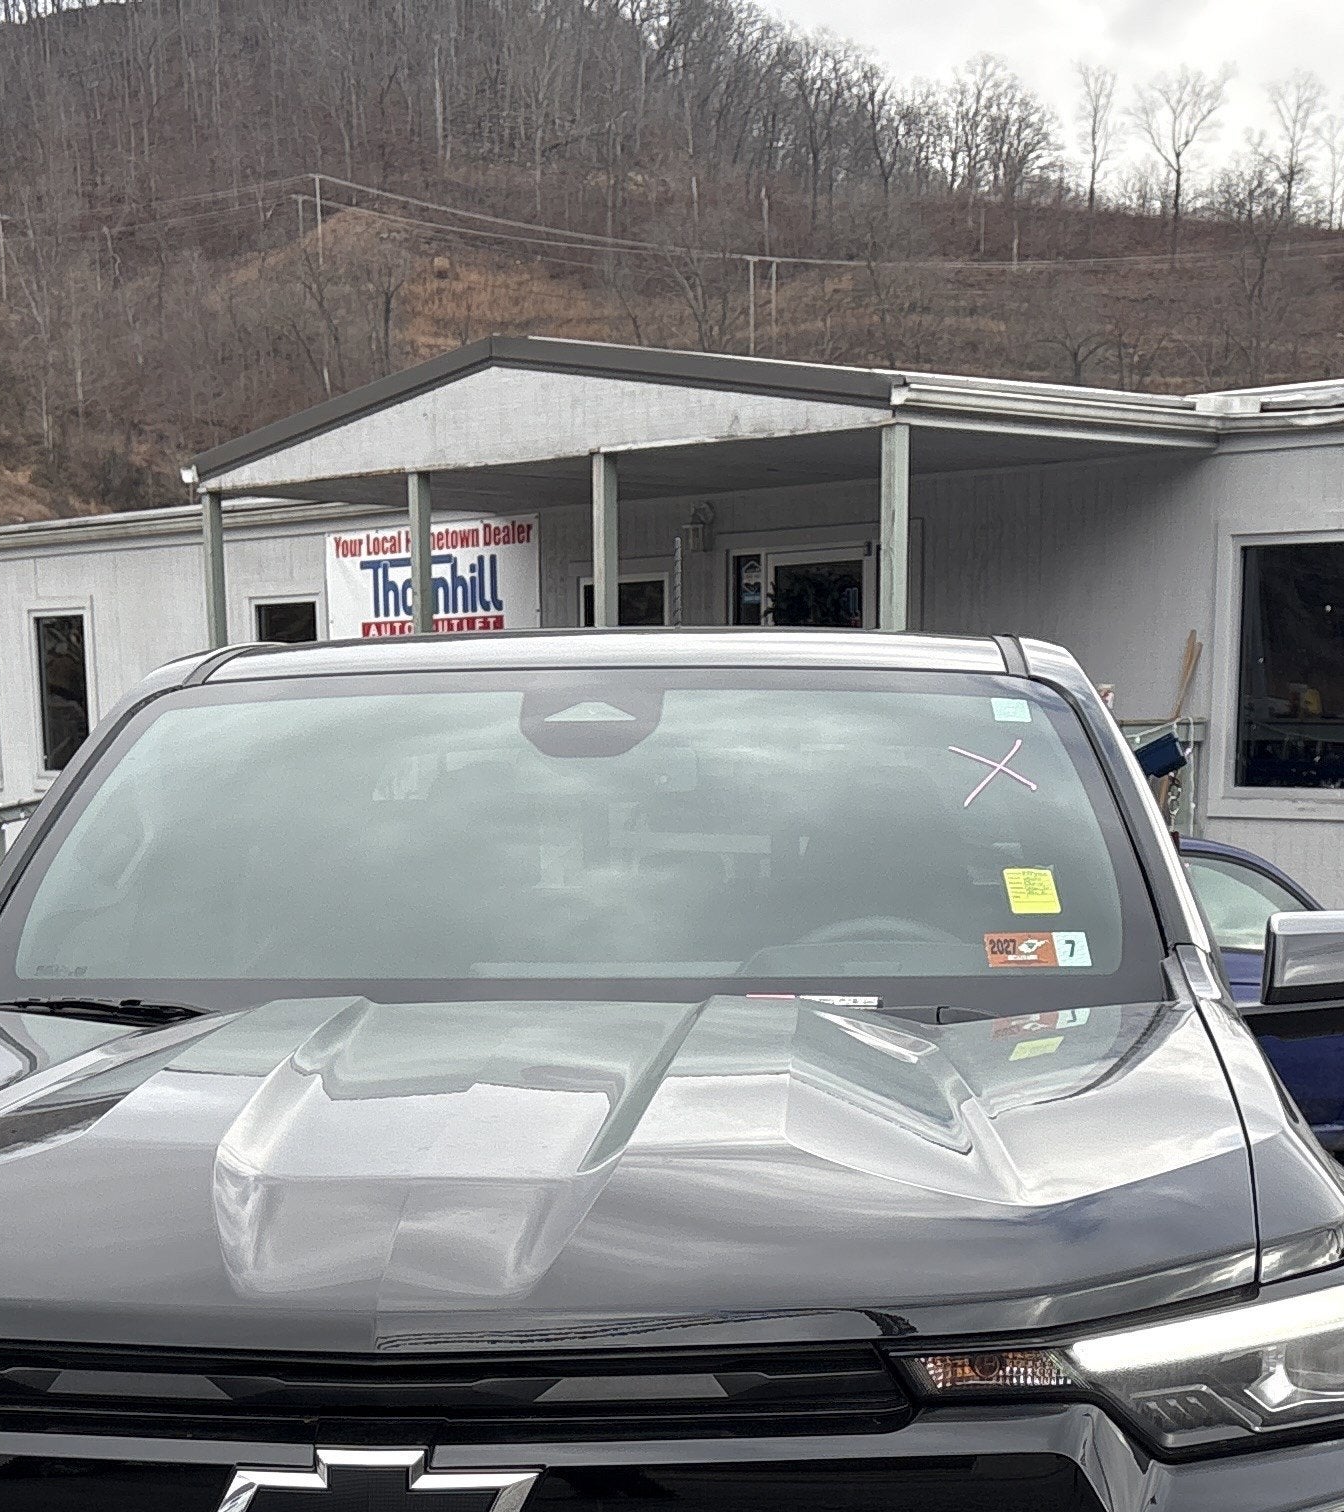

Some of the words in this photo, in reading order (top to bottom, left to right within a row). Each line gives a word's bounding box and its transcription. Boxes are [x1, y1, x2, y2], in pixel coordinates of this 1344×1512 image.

[334, 536, 363, 558] Your
[366, 533, 401, 556] Local
[405, 527, 480, 553] Hetown
[483, 520, 533, 546] Dealer
[360, 554, 503, 618] Thonhill
[369, 622, 414, 637] AUTO
[432, 618, 496, 632] UTLET
[988, 939, 1017, 955] 2027
[1064, 939, 1076, 957] 7
